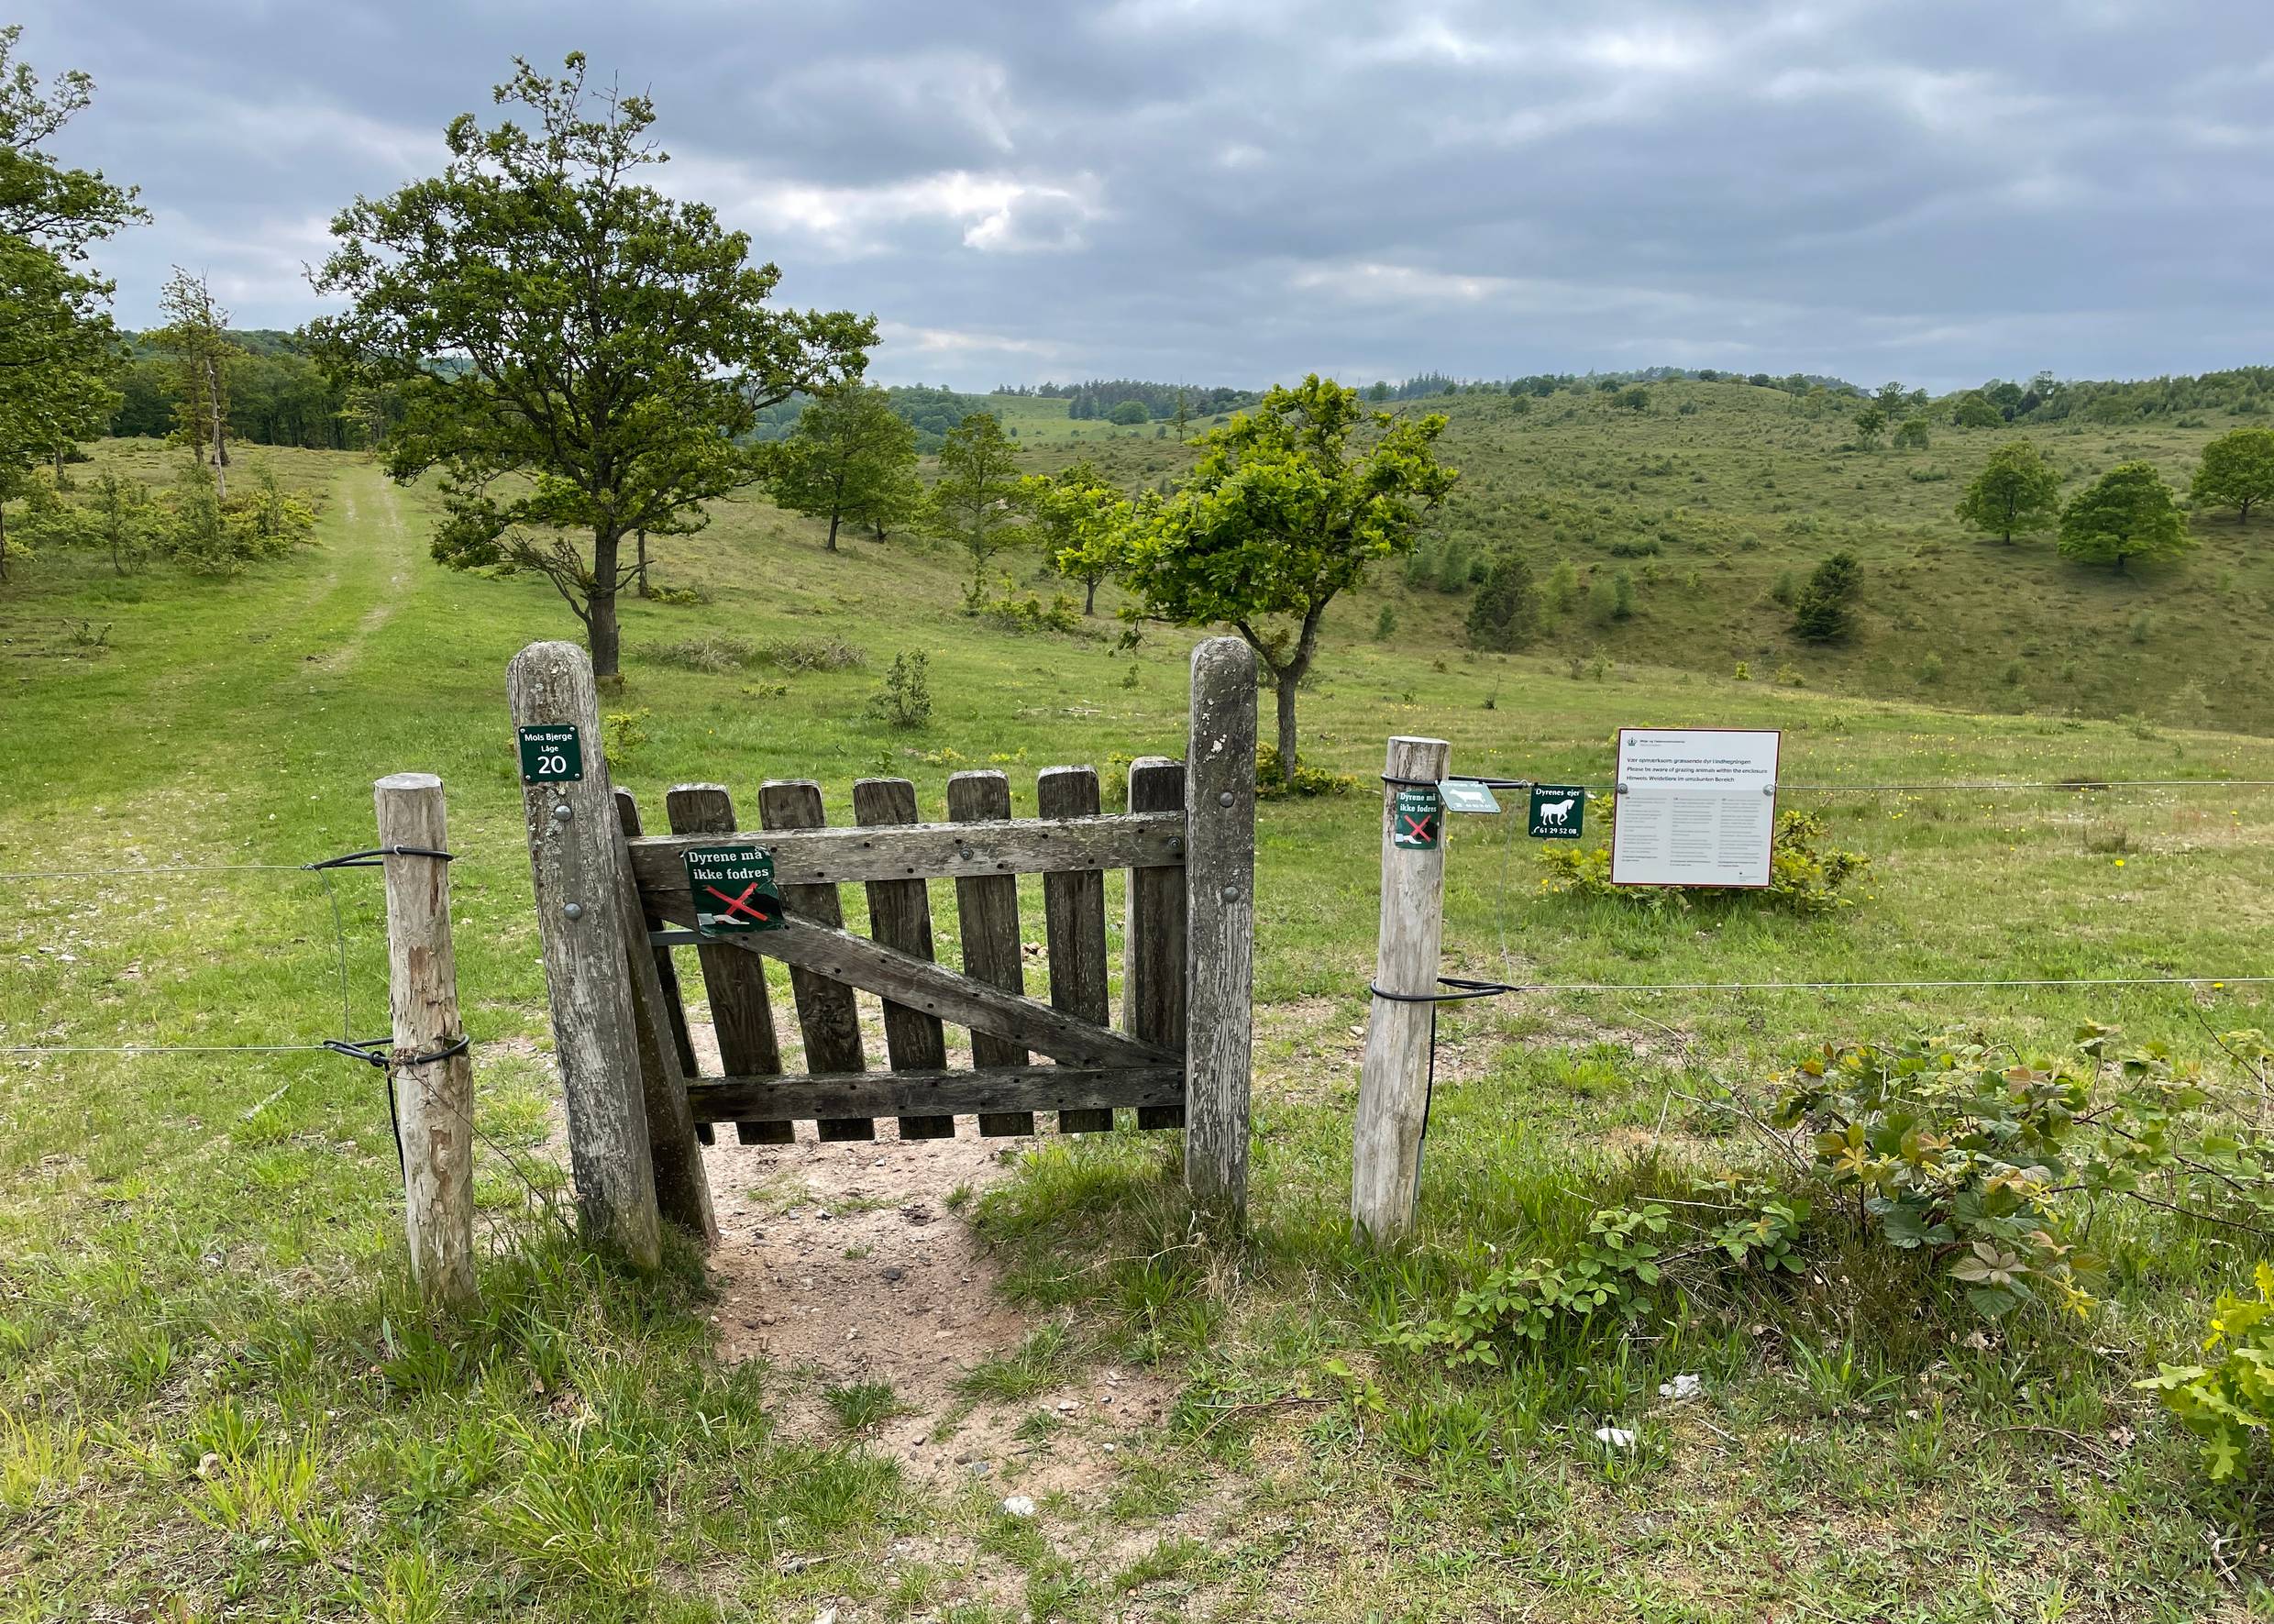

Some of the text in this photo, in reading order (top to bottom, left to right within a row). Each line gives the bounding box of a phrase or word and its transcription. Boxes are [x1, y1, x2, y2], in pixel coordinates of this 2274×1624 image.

[546, 733, 573, 742] Bjerge
[537, 755, 567, 774] 20
[1400, 792, 1436, 801] Dyrene må
[1536, 788, 1564, 796] Dyrenes
[1400, 803, 1415, 812] ikke
[688, 848, 763, 865] Dyrene må
[693, 868, 769, 879] ikke fodres
